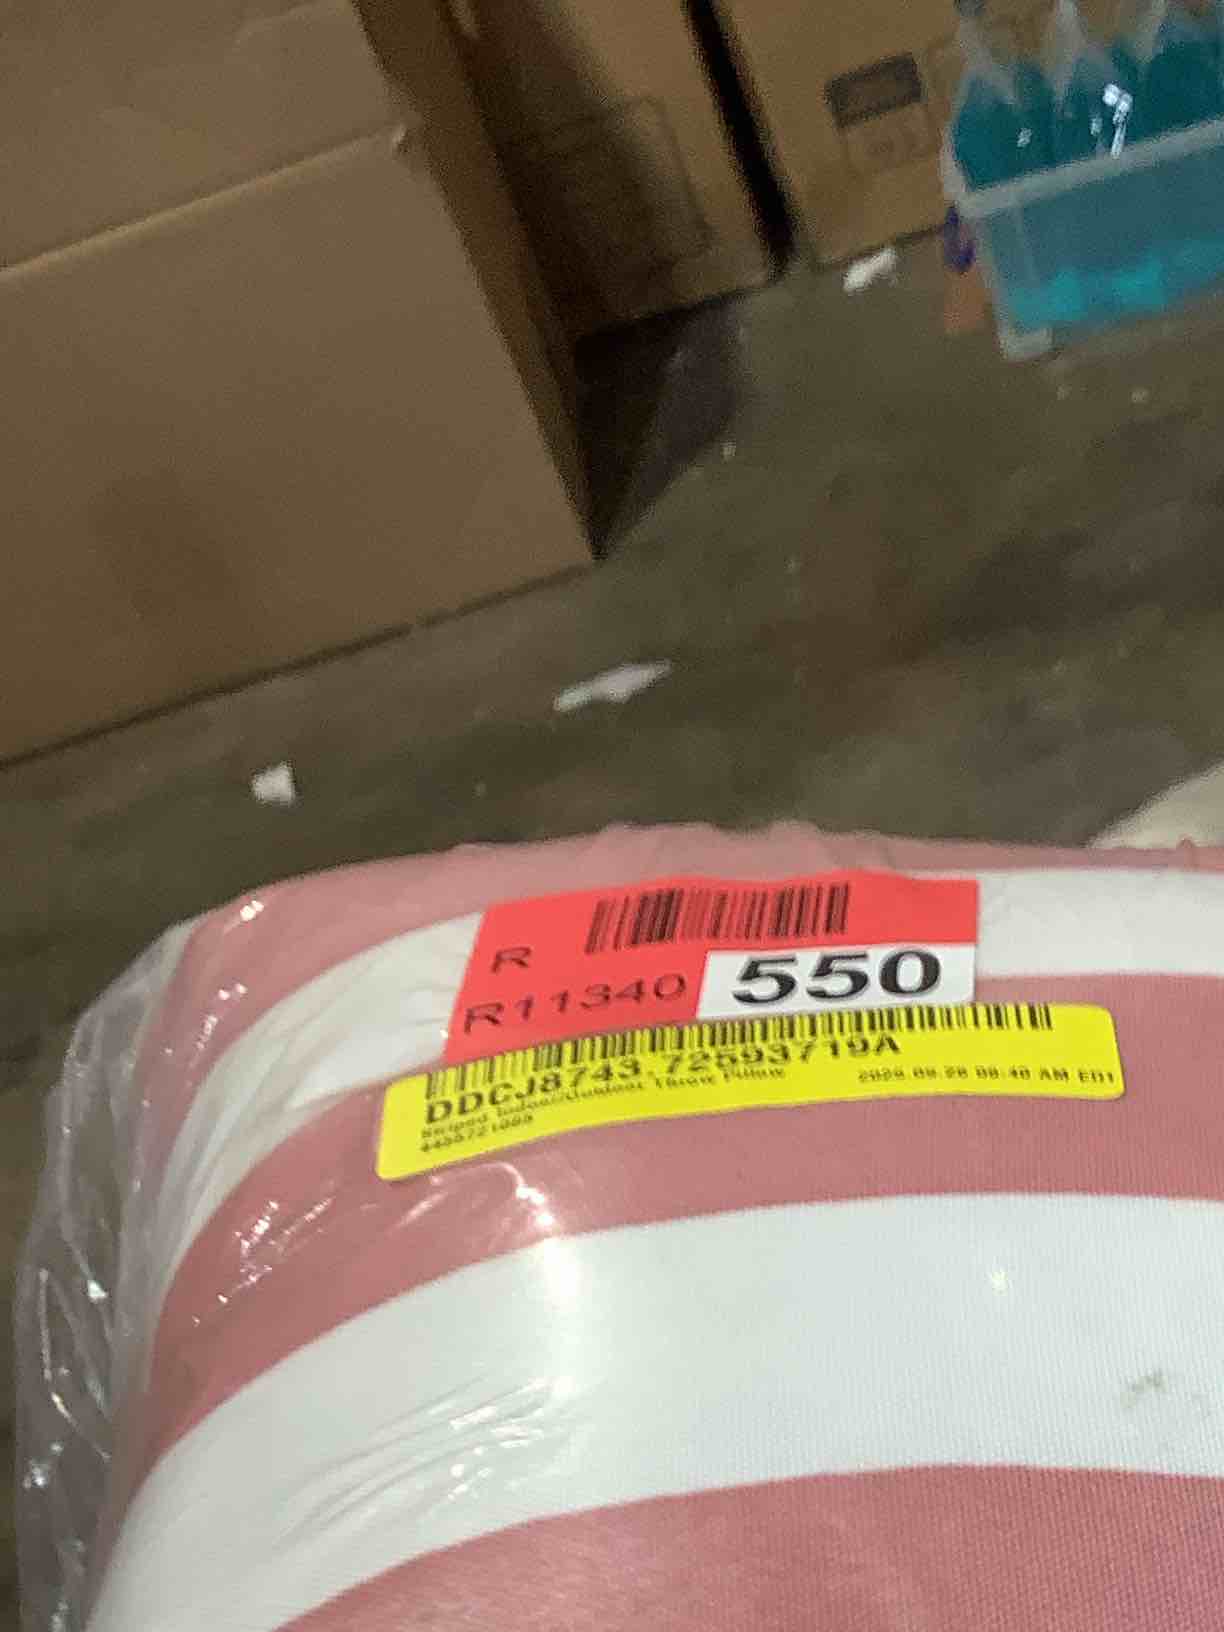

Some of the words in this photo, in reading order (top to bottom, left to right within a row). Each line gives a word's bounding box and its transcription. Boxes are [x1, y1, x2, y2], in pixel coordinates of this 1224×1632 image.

[490, 946, 533, 975] R
[731, 949, 941, 1004] 550
[463, 974, 688, 1035] R11340
